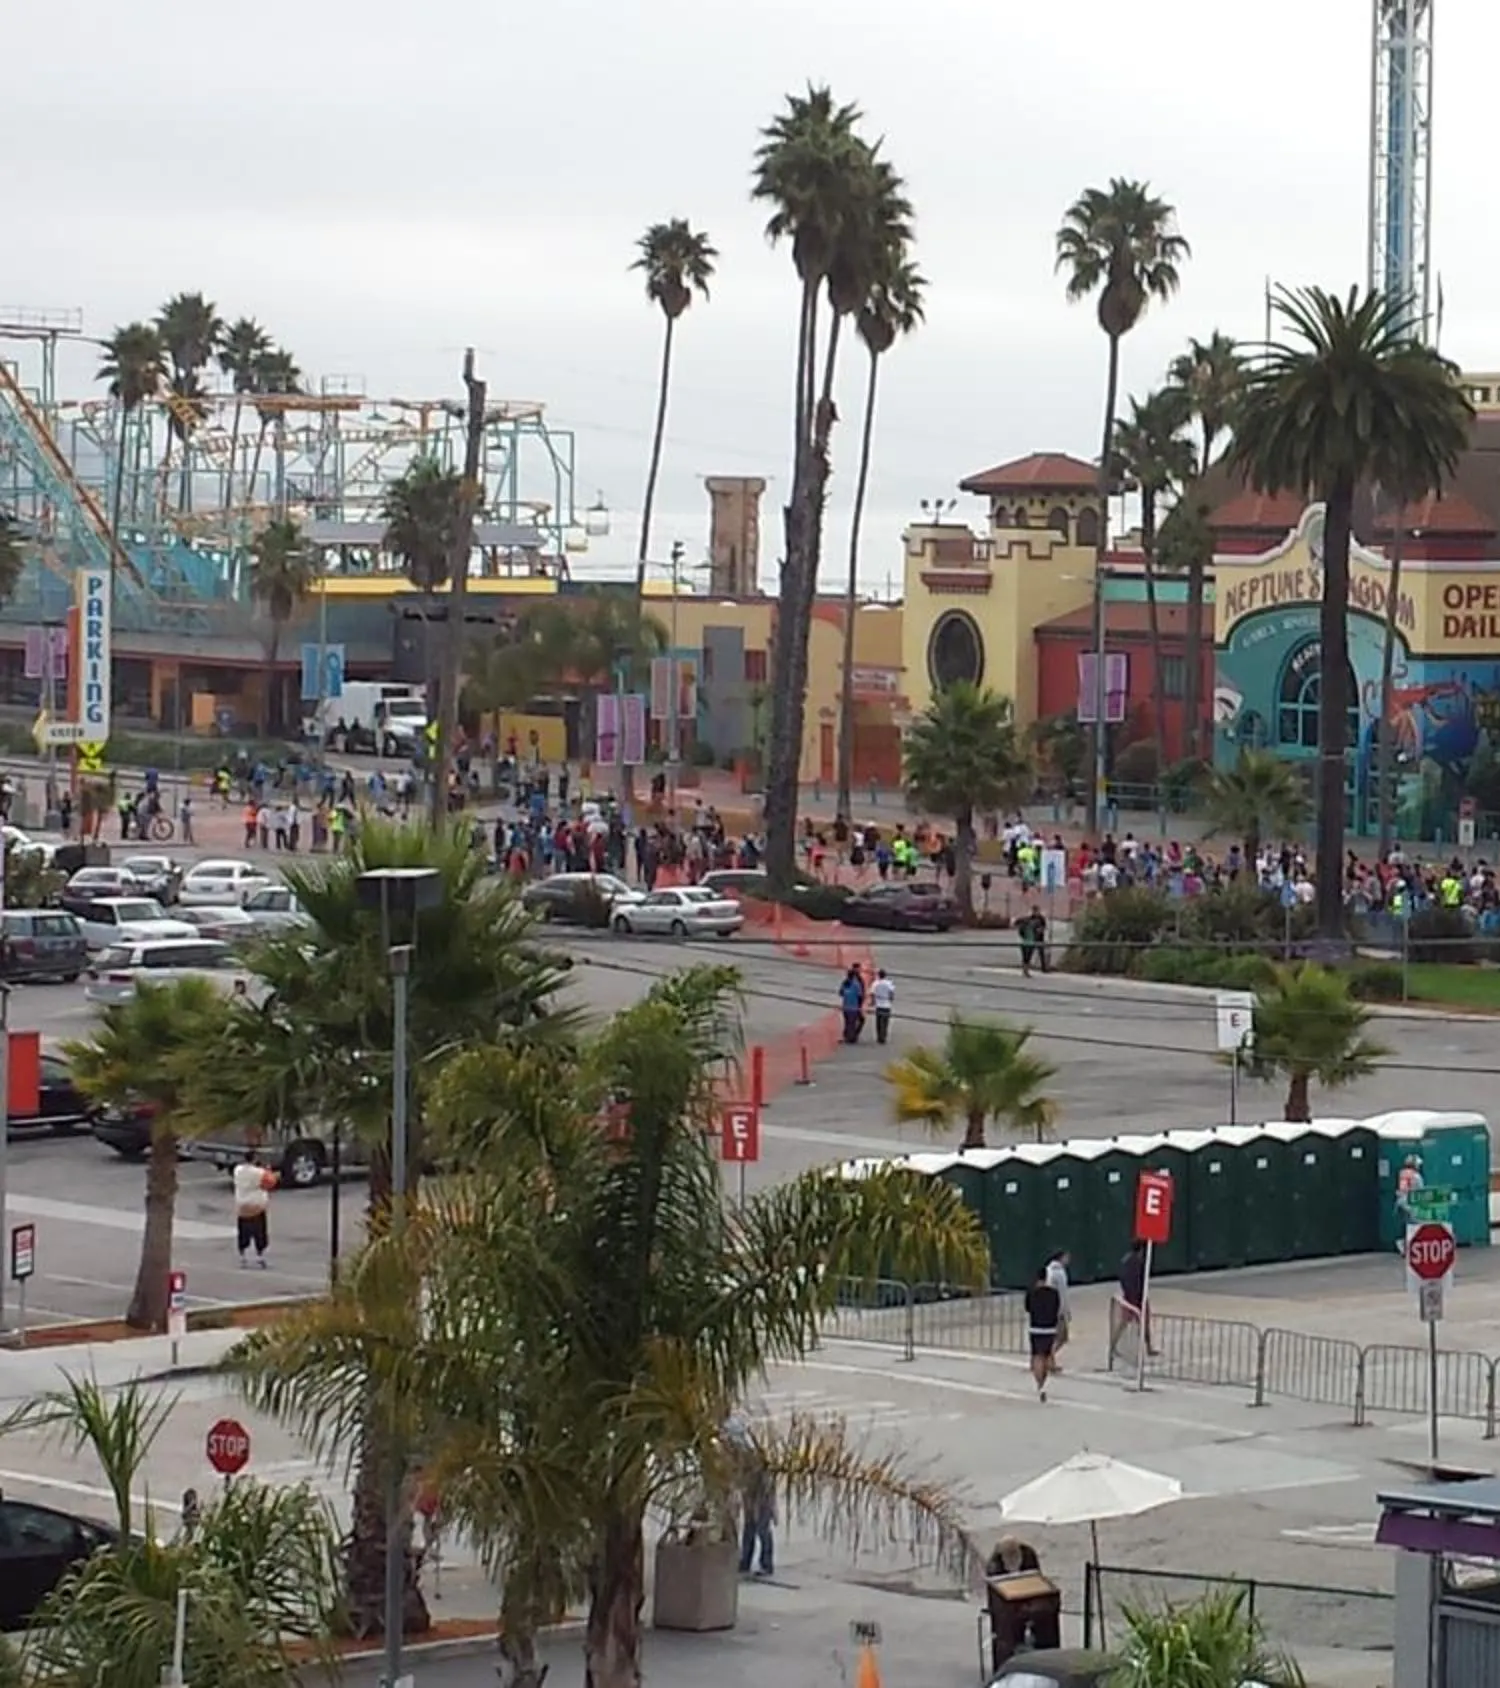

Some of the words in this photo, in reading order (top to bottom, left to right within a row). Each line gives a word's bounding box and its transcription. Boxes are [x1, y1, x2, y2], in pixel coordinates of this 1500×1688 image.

[87, 577, 103, 724] PARKING
[1231, 1012, 1241, 1028] E
[732, 1115, 748, 1138] E
[1146, 1187, 1162, 1216] E
[1411, 1240, 1452, 1264] STOP
[209, 1435, 246, 1457] STOP
